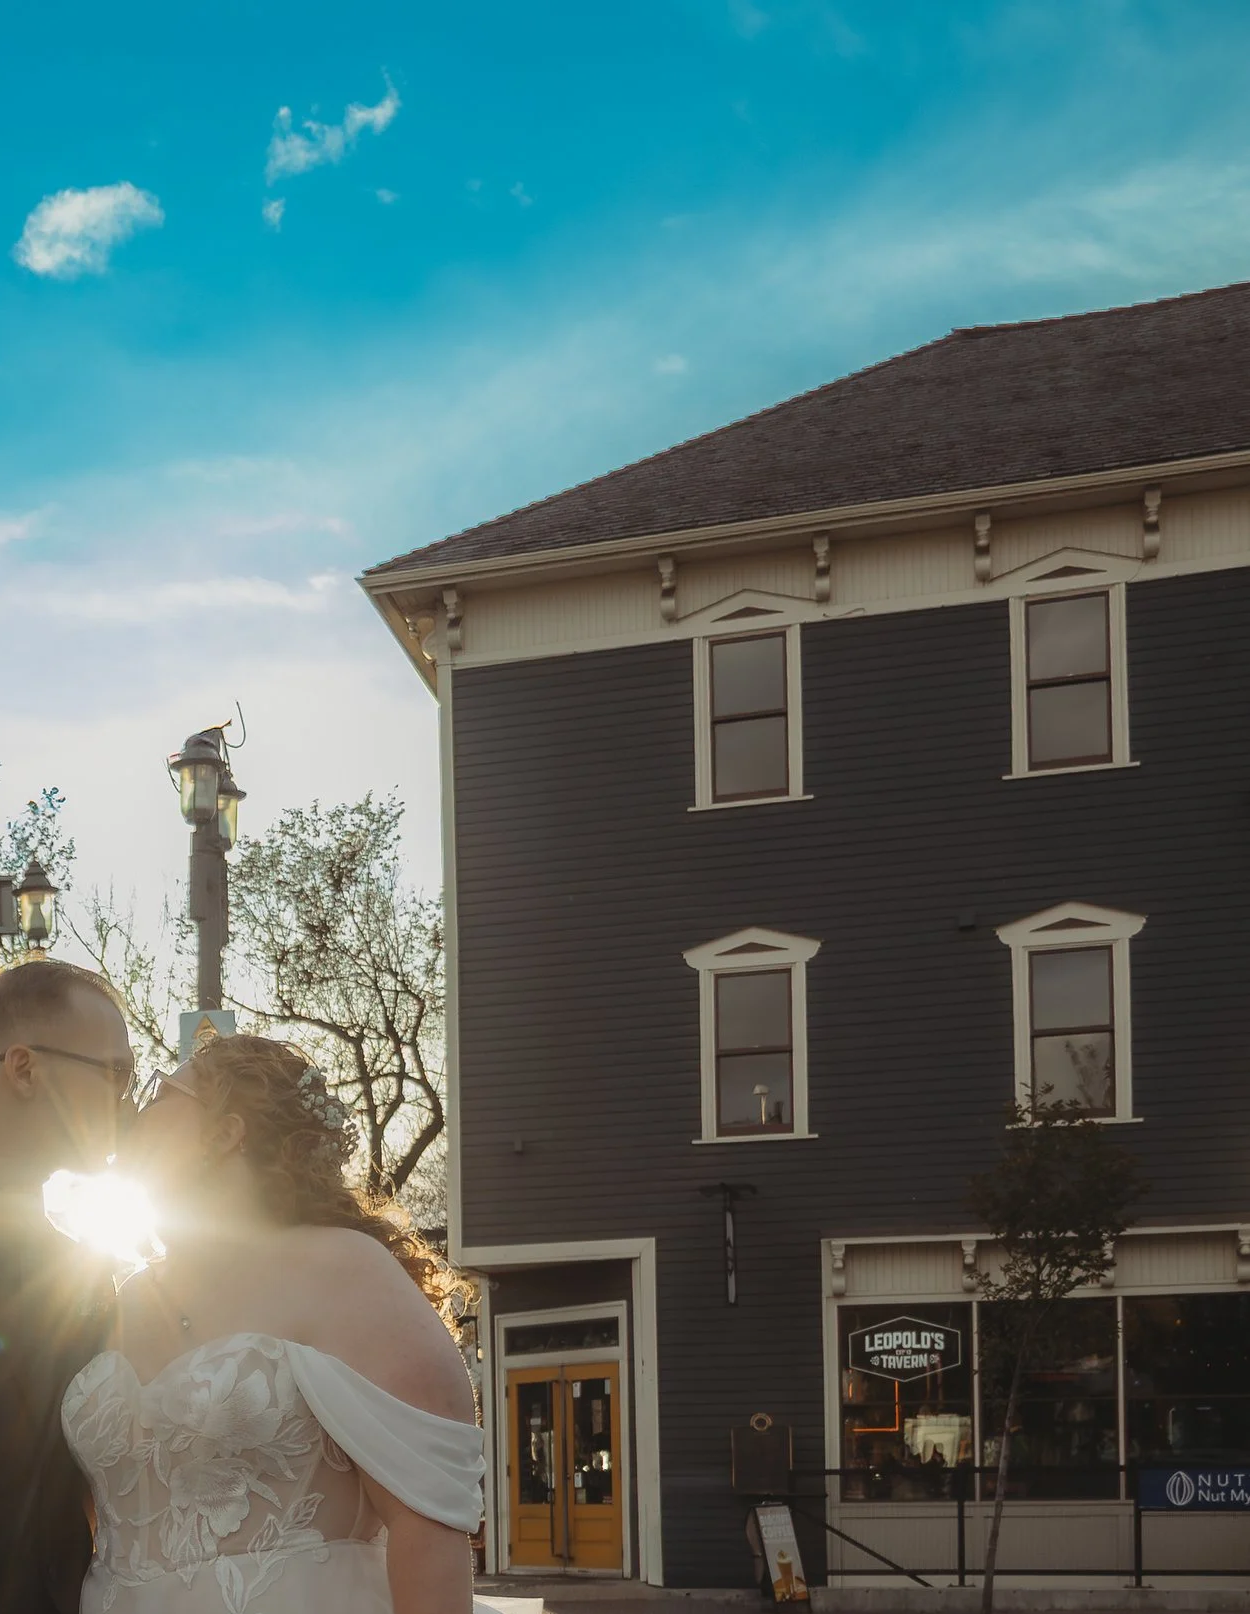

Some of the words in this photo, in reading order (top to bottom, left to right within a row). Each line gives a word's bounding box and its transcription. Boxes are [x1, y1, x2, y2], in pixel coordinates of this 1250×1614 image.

[864, 1331, 946, 1353] LEOPOLD'S
[880, 1353, 928, 1369] TAVERN
[1198, 1488, 1226, 1502] Nut
